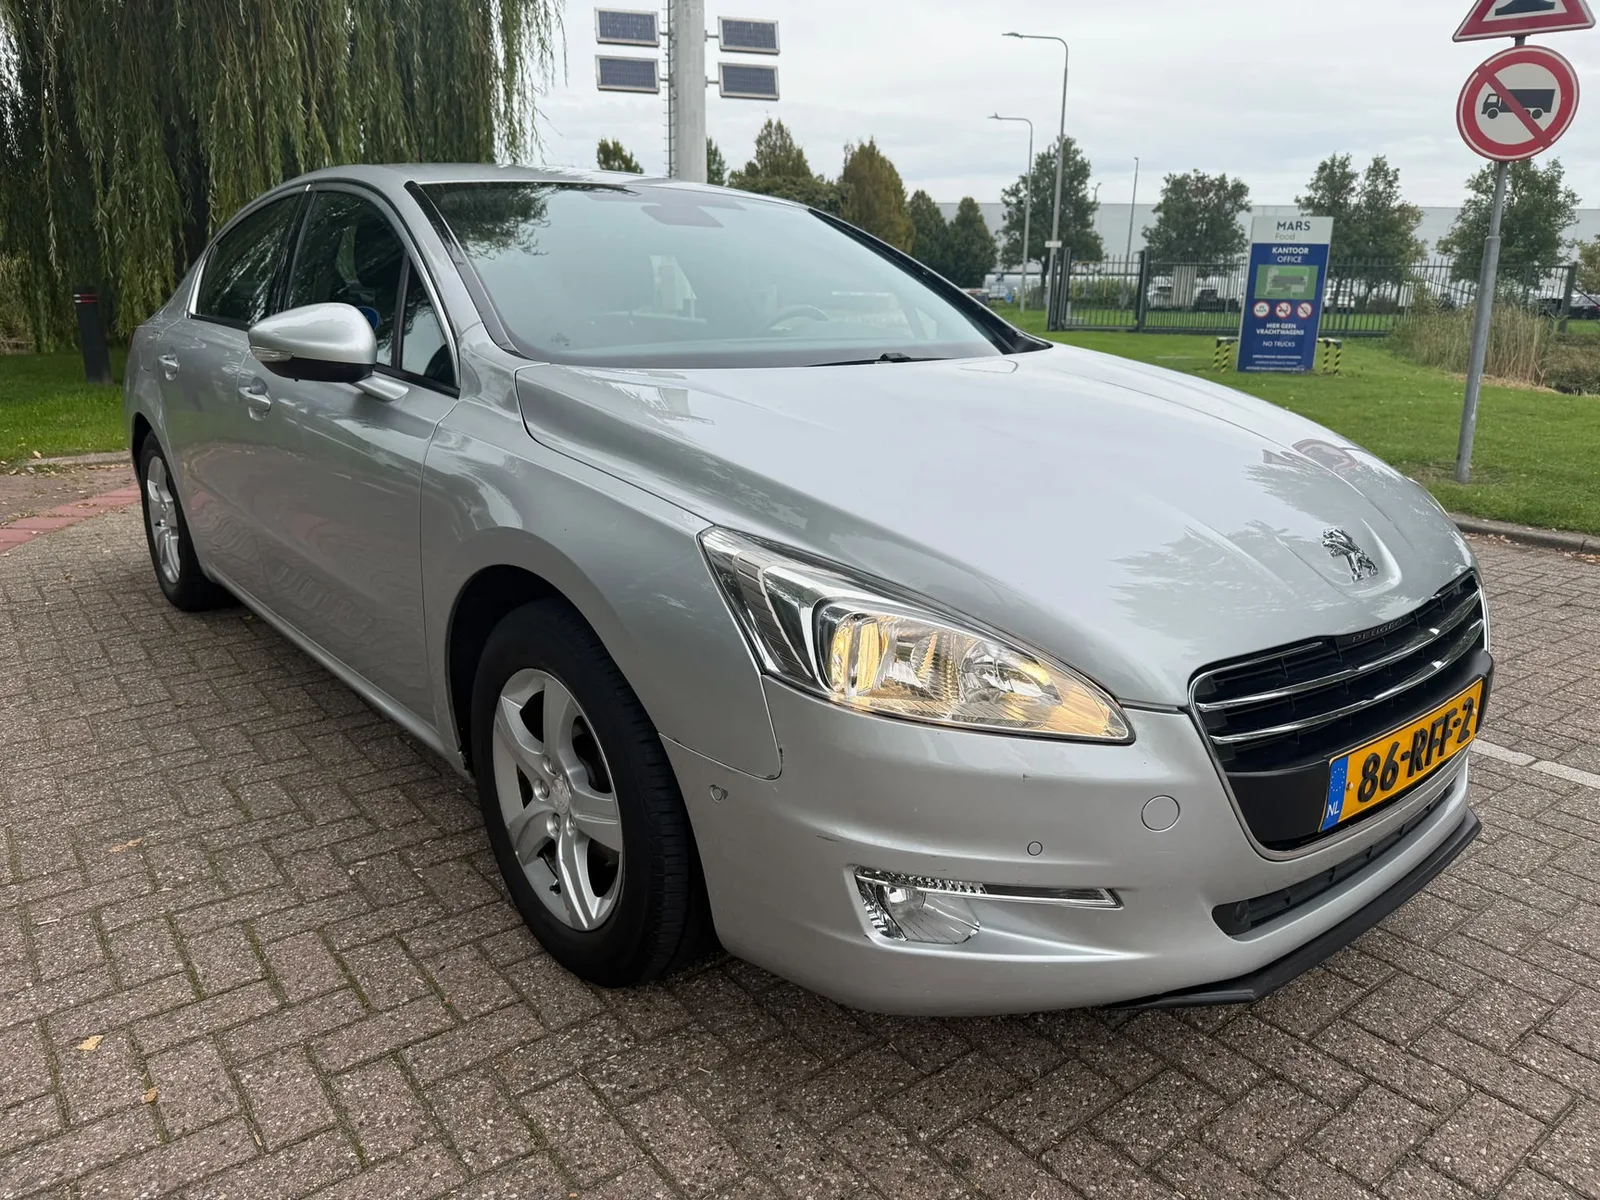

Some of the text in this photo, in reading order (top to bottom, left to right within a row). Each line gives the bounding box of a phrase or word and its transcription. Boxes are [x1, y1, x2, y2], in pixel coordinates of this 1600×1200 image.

[1276, 220, 1311, 231] MARS
[1275, 232, 1295, 240] Food
[1272, 246, 1309, 255] KANTOOR
[1277, 255, 1302, 264] OFFICE
[1274, 340, 1296, 348] TRUCKS
[1357, 696, 1475, 803] 86-RFF-2
[1326, 800, 1340, 819] NL
